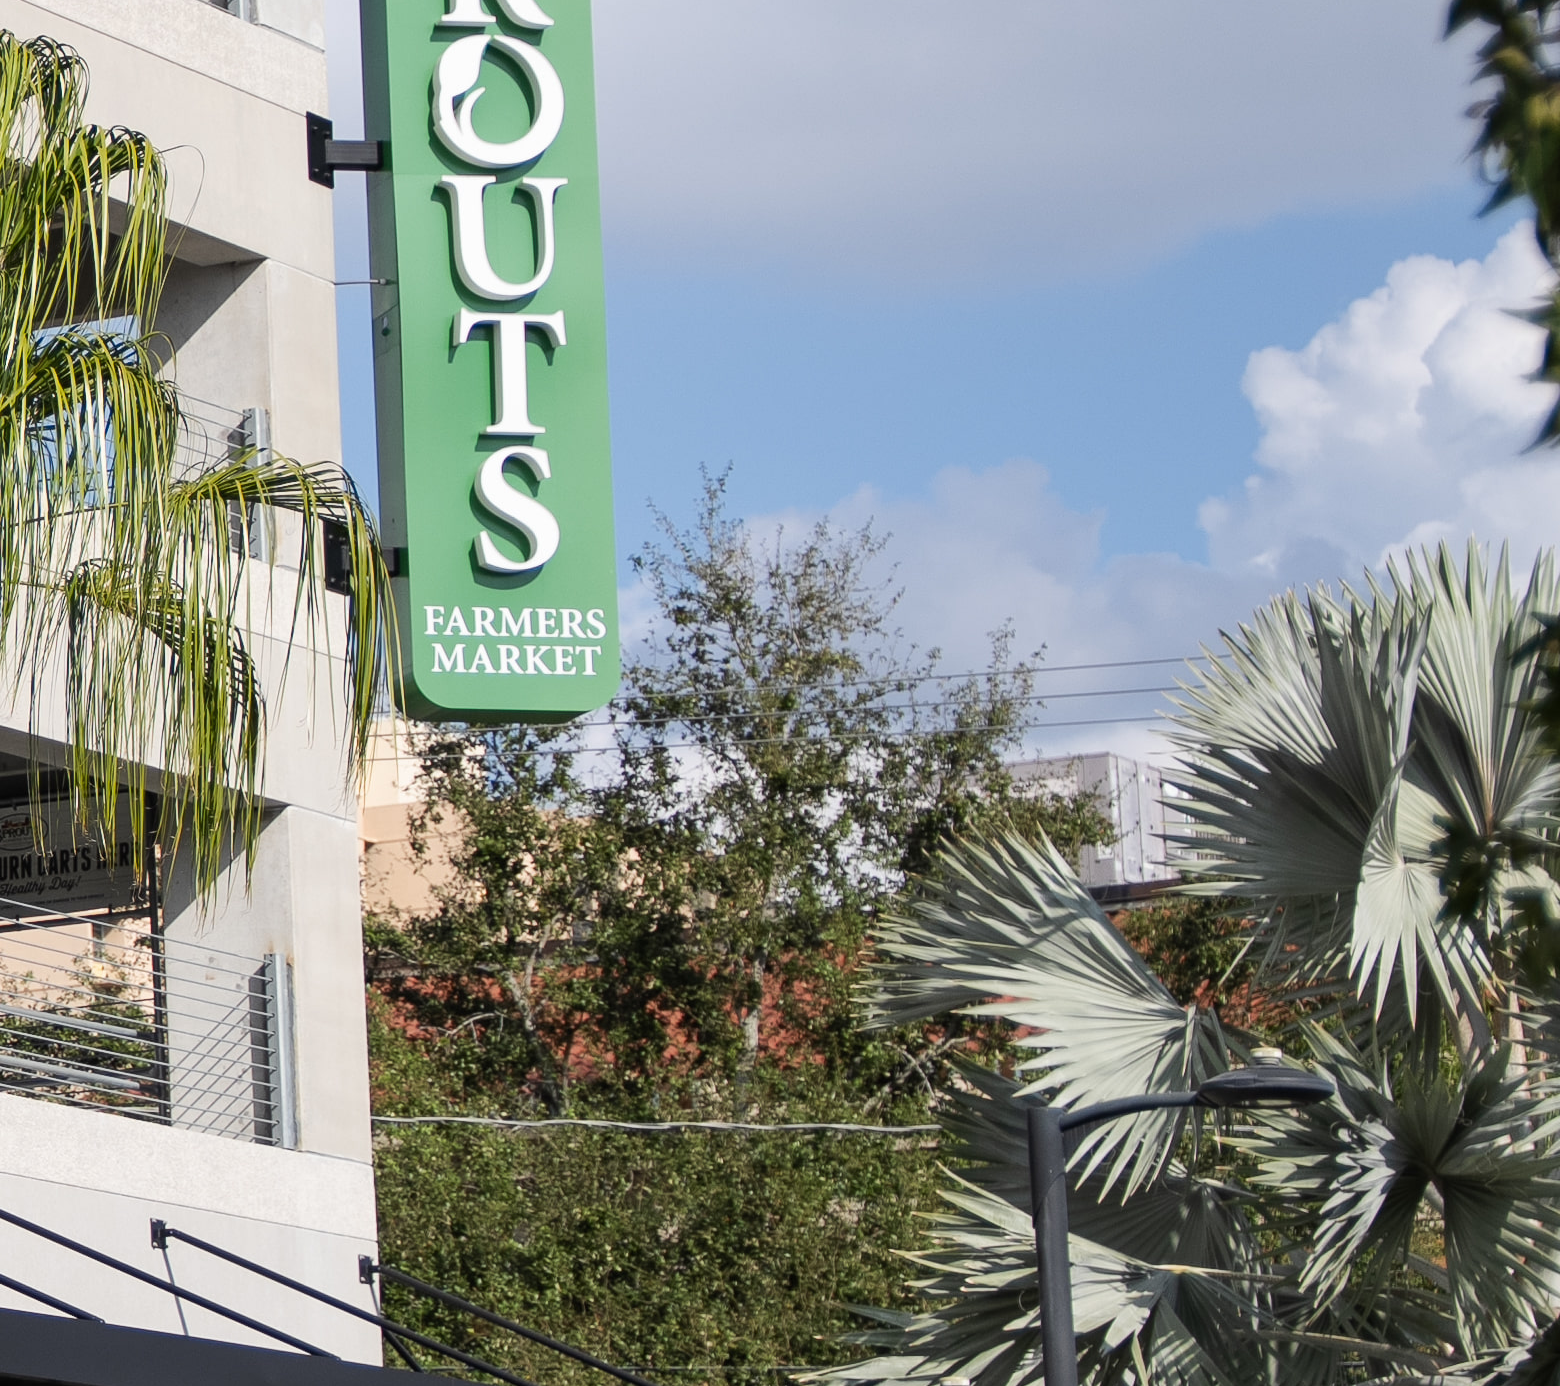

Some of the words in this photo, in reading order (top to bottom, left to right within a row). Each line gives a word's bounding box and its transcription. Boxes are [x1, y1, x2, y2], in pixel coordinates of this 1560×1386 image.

[423, 606, 607, 639] FARMERS
[431, 643, 602, 676] MARKET
[0, 880, 46, 897] Healthy
[48, 875, 82, 892] Day!
